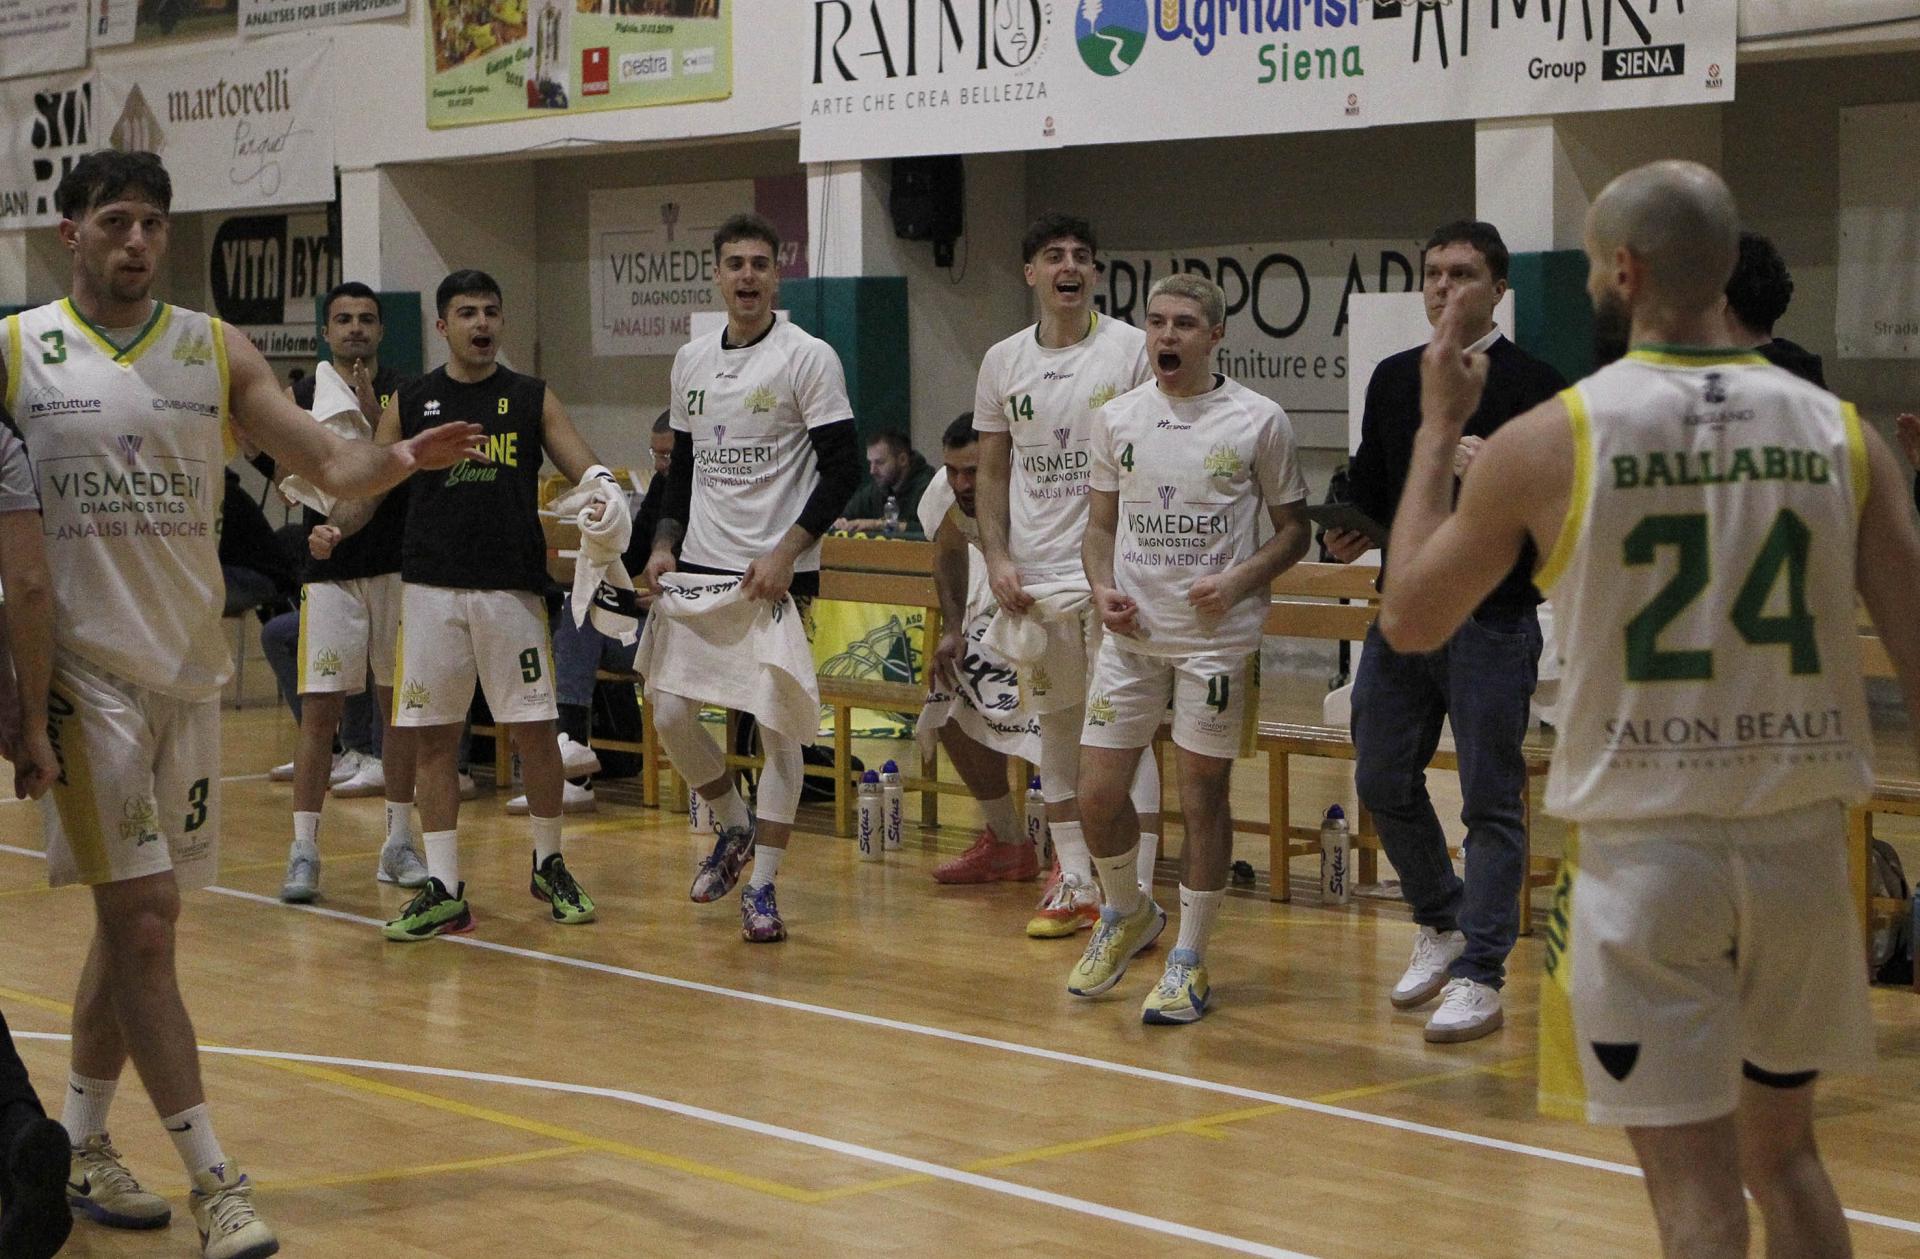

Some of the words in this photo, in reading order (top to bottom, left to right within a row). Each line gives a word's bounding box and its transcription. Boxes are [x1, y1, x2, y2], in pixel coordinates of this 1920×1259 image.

[245, 8, 295, 27] ANALYSES
[299, 5, 316, 20] FOR
[319, 3, 336, 17] LIFE
[1257, 43, 1364, 84] Siena
[1528, 57, 1587, 83] Group
[1615, 50, 1676, 77] SIENA
[168, 67, 291, 123] martorelli
[810, 98, 854, 117] ARTE
[863, 94, 896, 112] CHE
[906, 90, 950, 109] CREA
[960, 81, 1048, 105] BELLEZZA
[222, 236, 280, 300] VITA
[610, 250, 713, 284] VISMEDE
[632, 288, 712, 306] DIAGNOSTICS
[611, 317, 666, 337] ANALISI
[41, 329, 68, 365] 3
[1216, 349, 1306, 379] finiture
[1313, 358, 1327, 378] e
[497, 397, 510, 416] 9
[687, 389, 706, 416] 21
[1009, 394, 1035, 422] 14
[1022, 451, 1090, 473] VISMED
[1121, 442, 1135, 473] 4
[444, 458, 499, 488] Siena
[1036, 470, 1091, 484] DIAGNOSTI
[80, 500, 186, 516] DIAGNOSTICS
[56, 521, 129, 542] ANALISI
[134, 521, 208, 538] MEDICHE
[1165, 553, 1227, 567] MEDICHE
[1623, 507, 1823, 682] 24
[519, 647, 543, 684] 9
[1605, 716, 1720, 745] SALON
[184, 777, 210, 833] 3
[860, 807, 874, 855] Sixtus
[887, 798, 900, 844] Sixtus
[1329, 845, 1346, 896] Sixtus
